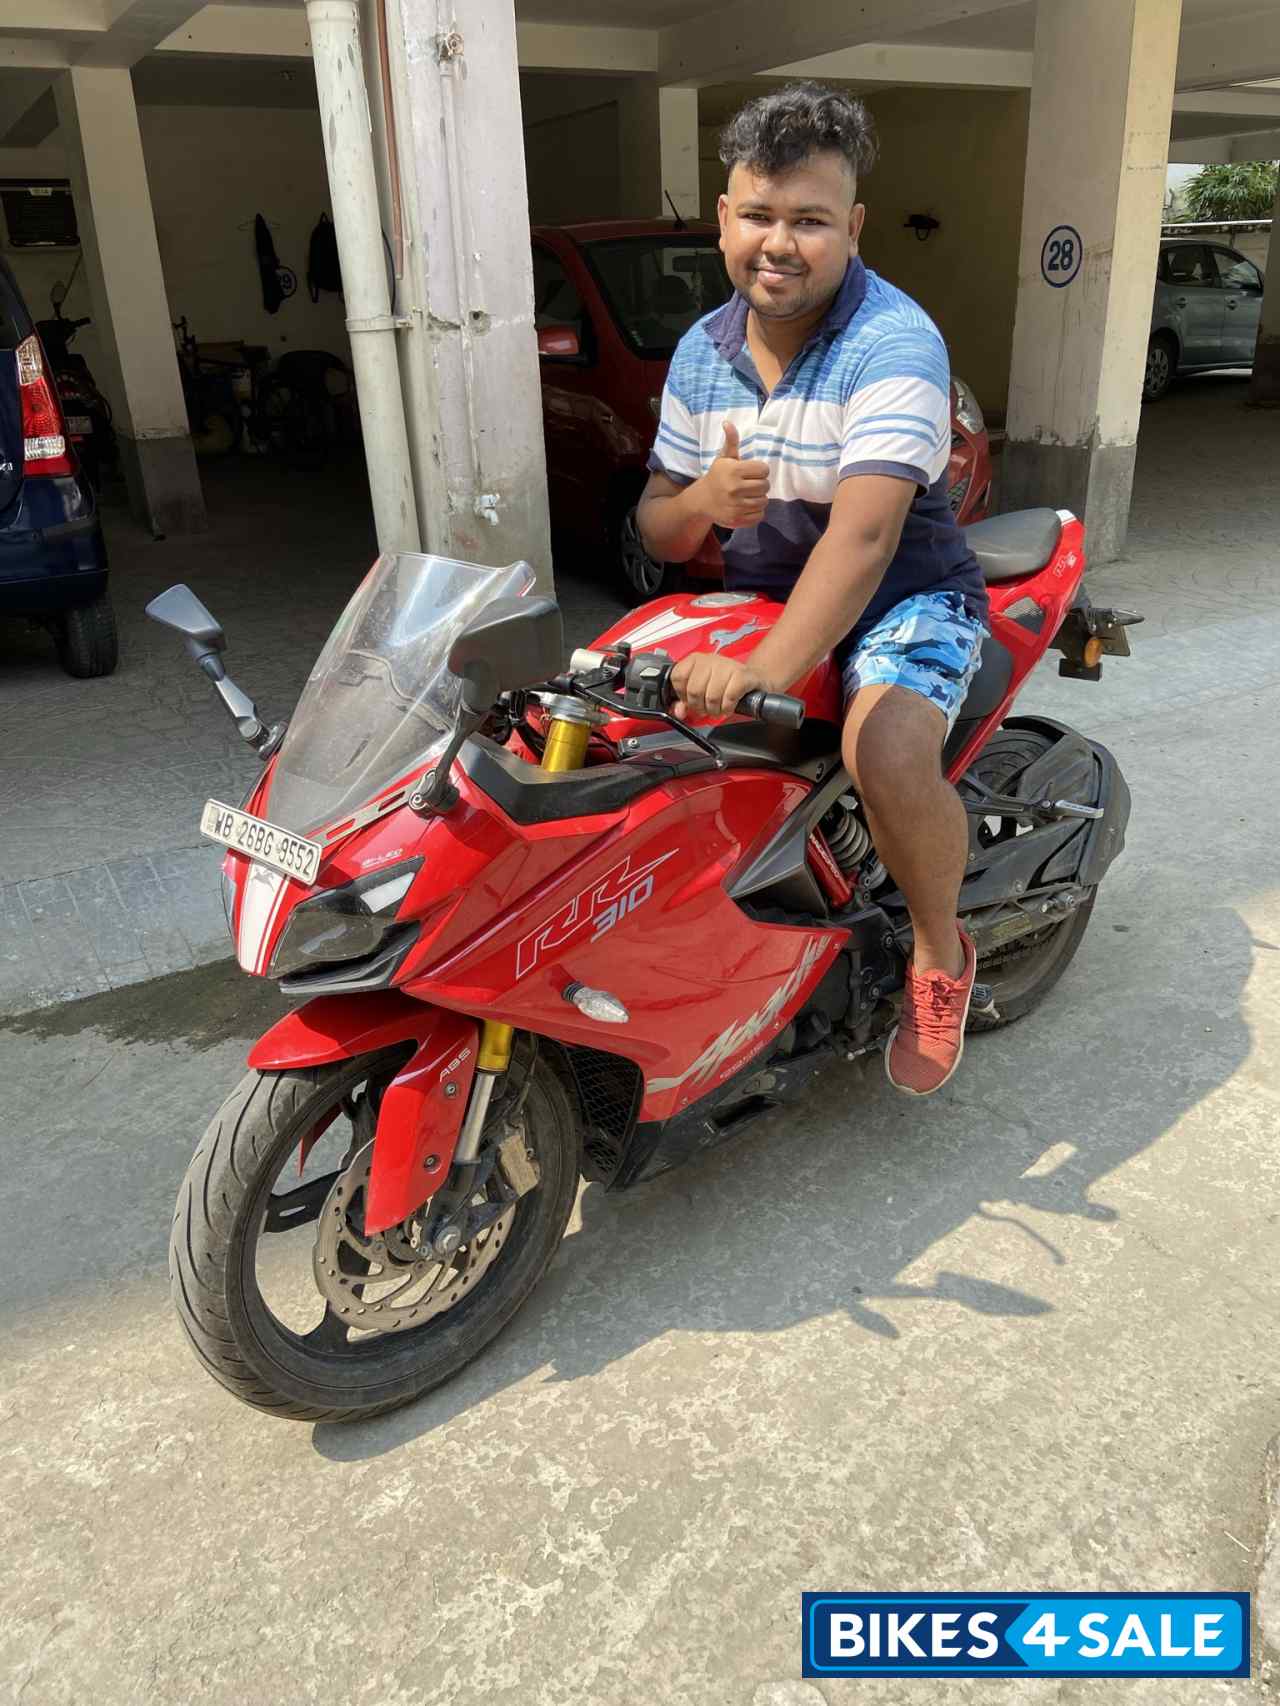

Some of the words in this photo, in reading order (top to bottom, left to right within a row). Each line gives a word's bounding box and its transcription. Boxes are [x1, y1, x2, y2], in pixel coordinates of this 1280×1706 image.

[1047, 239, 1074, 271] 28
[279, 838, 315, 876] 9552
[516, 848, 680, 980] RR
[590, 874, 655, 944] 310
[440, 1047, 472, 1083] ABS
